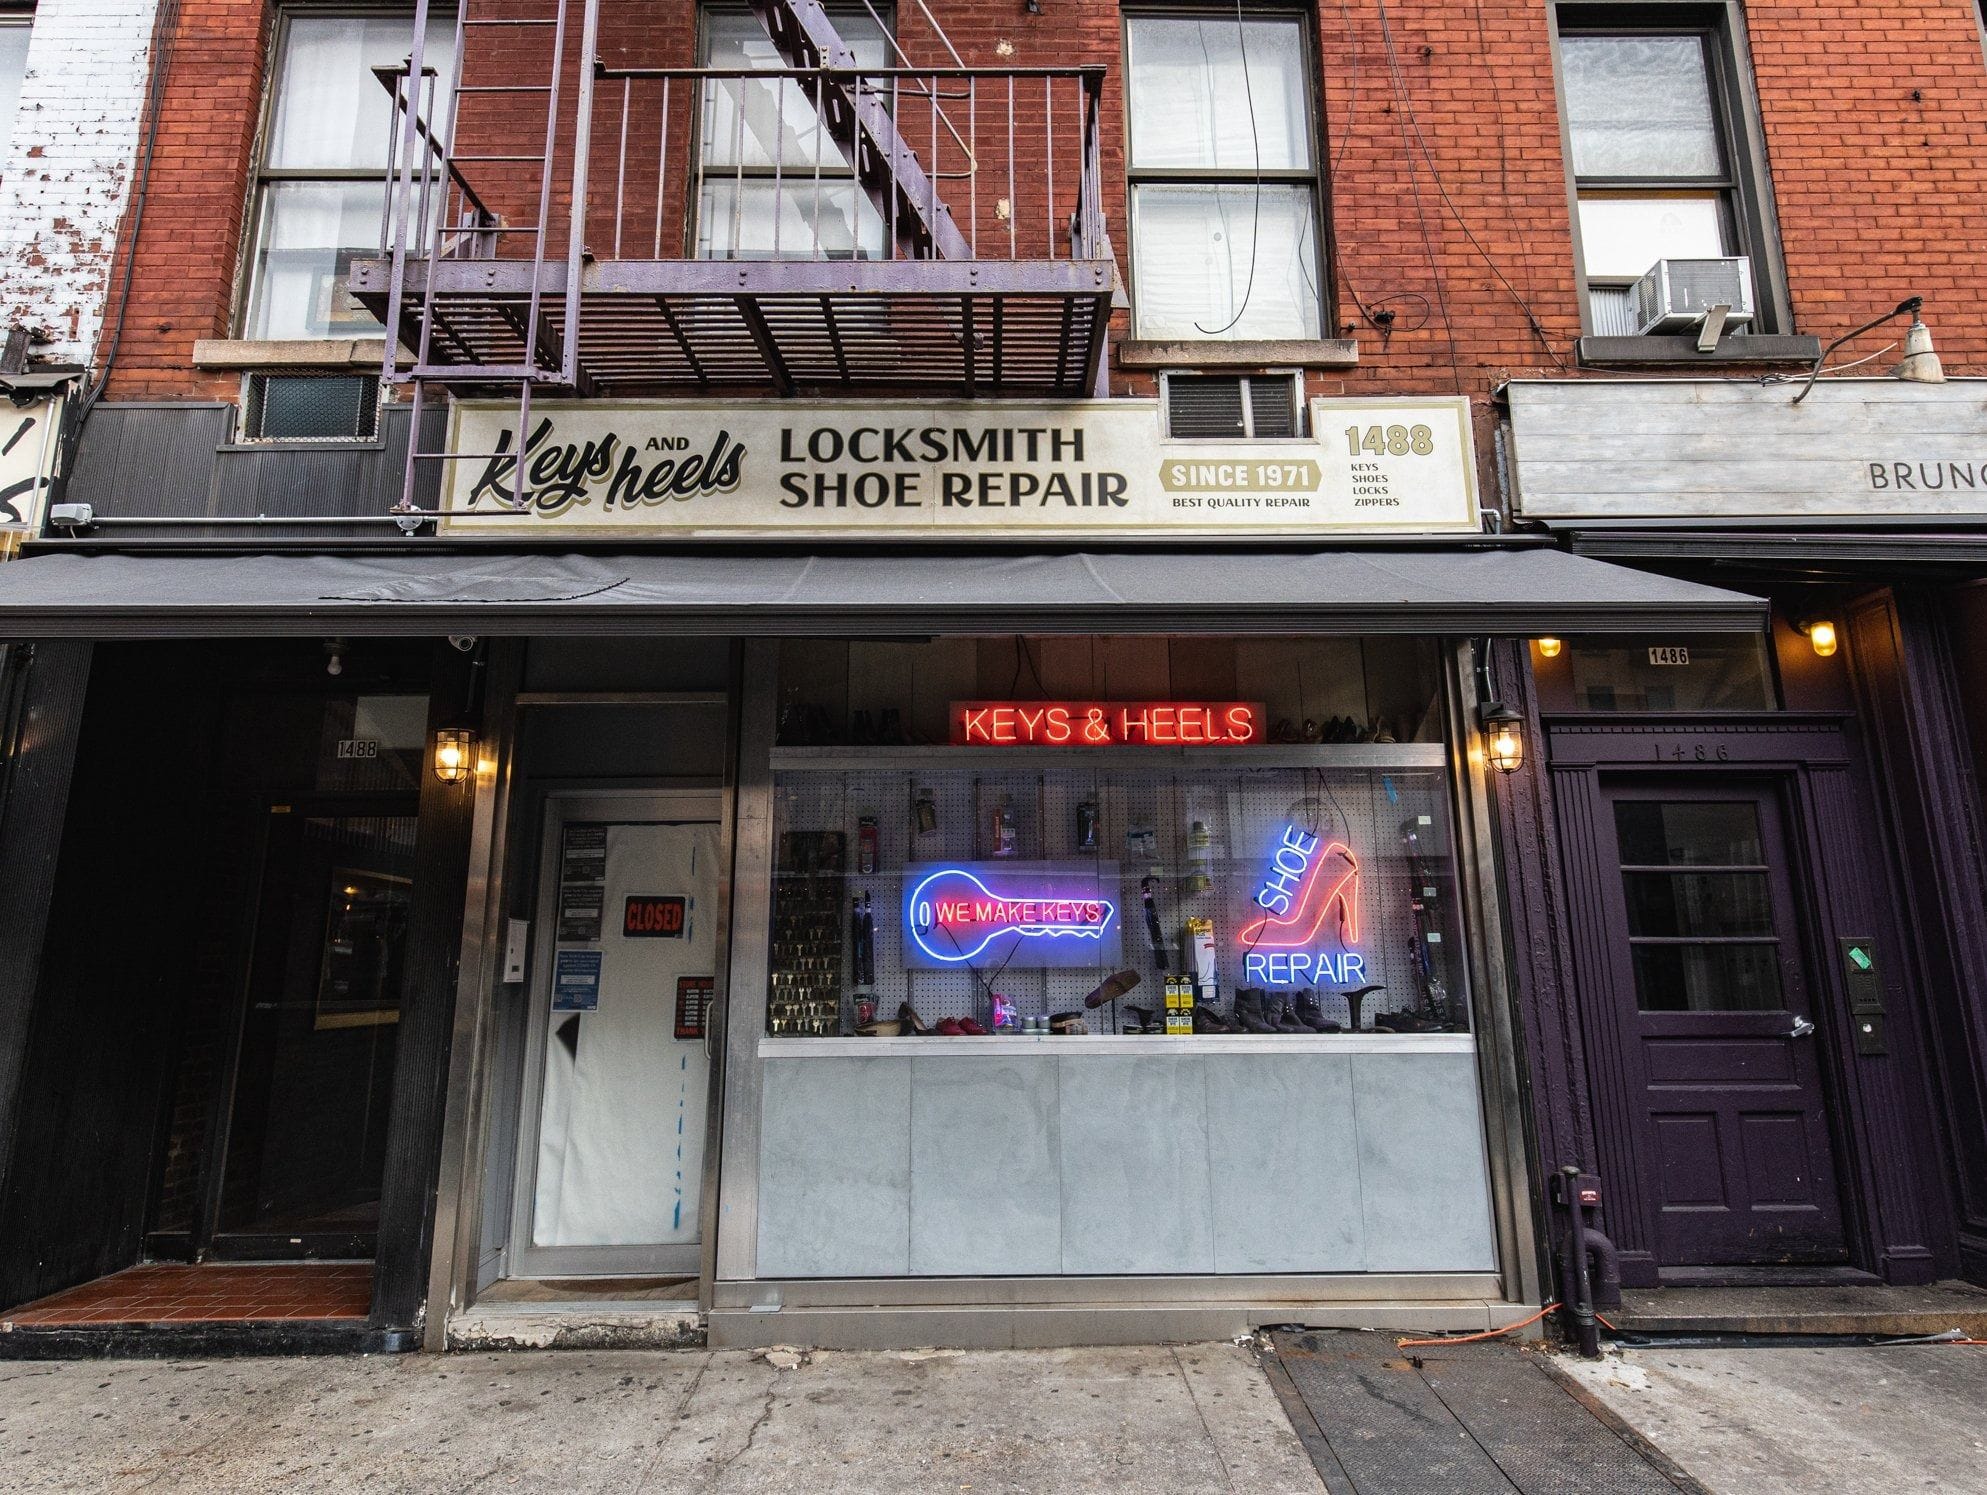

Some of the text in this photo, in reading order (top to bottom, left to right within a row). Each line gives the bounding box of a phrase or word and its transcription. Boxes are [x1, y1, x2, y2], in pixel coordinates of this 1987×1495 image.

[780, 427, 1085, 463] LOCKSMITH
[1345, 424, 1434, 456] 1488
[467, 417, 747, 515] Keys AND heels
[1171, 464, 1310, 486] SINCE 1971
[1351, 463, 1379, 472] KEYS
[1352, 474, 1389, 483] SHOES
[779, 472, 1130, 508] SHOE REPAIR
[1352, 486, 1389, 495] LOCKS
[1172, 497, 1311, 509] BEST QUALITY REPAIR
[1354, 498, 1400, 507] ZIPPERS
[1651, 648, 1687, 664] 1486
[965, 707, 1253, 742] KEYS & HEELS
[339, 741, 377, 757] 1488
[1655, 743, 1728, 761] 1486
[1258, 825, 1319, 916] SHOE
[626, 902, 683, 931] CLOSED
[935, 902, 1100, 923] WE MAKE KEYS
[1246, 953, 1366, 983] REPAIR
